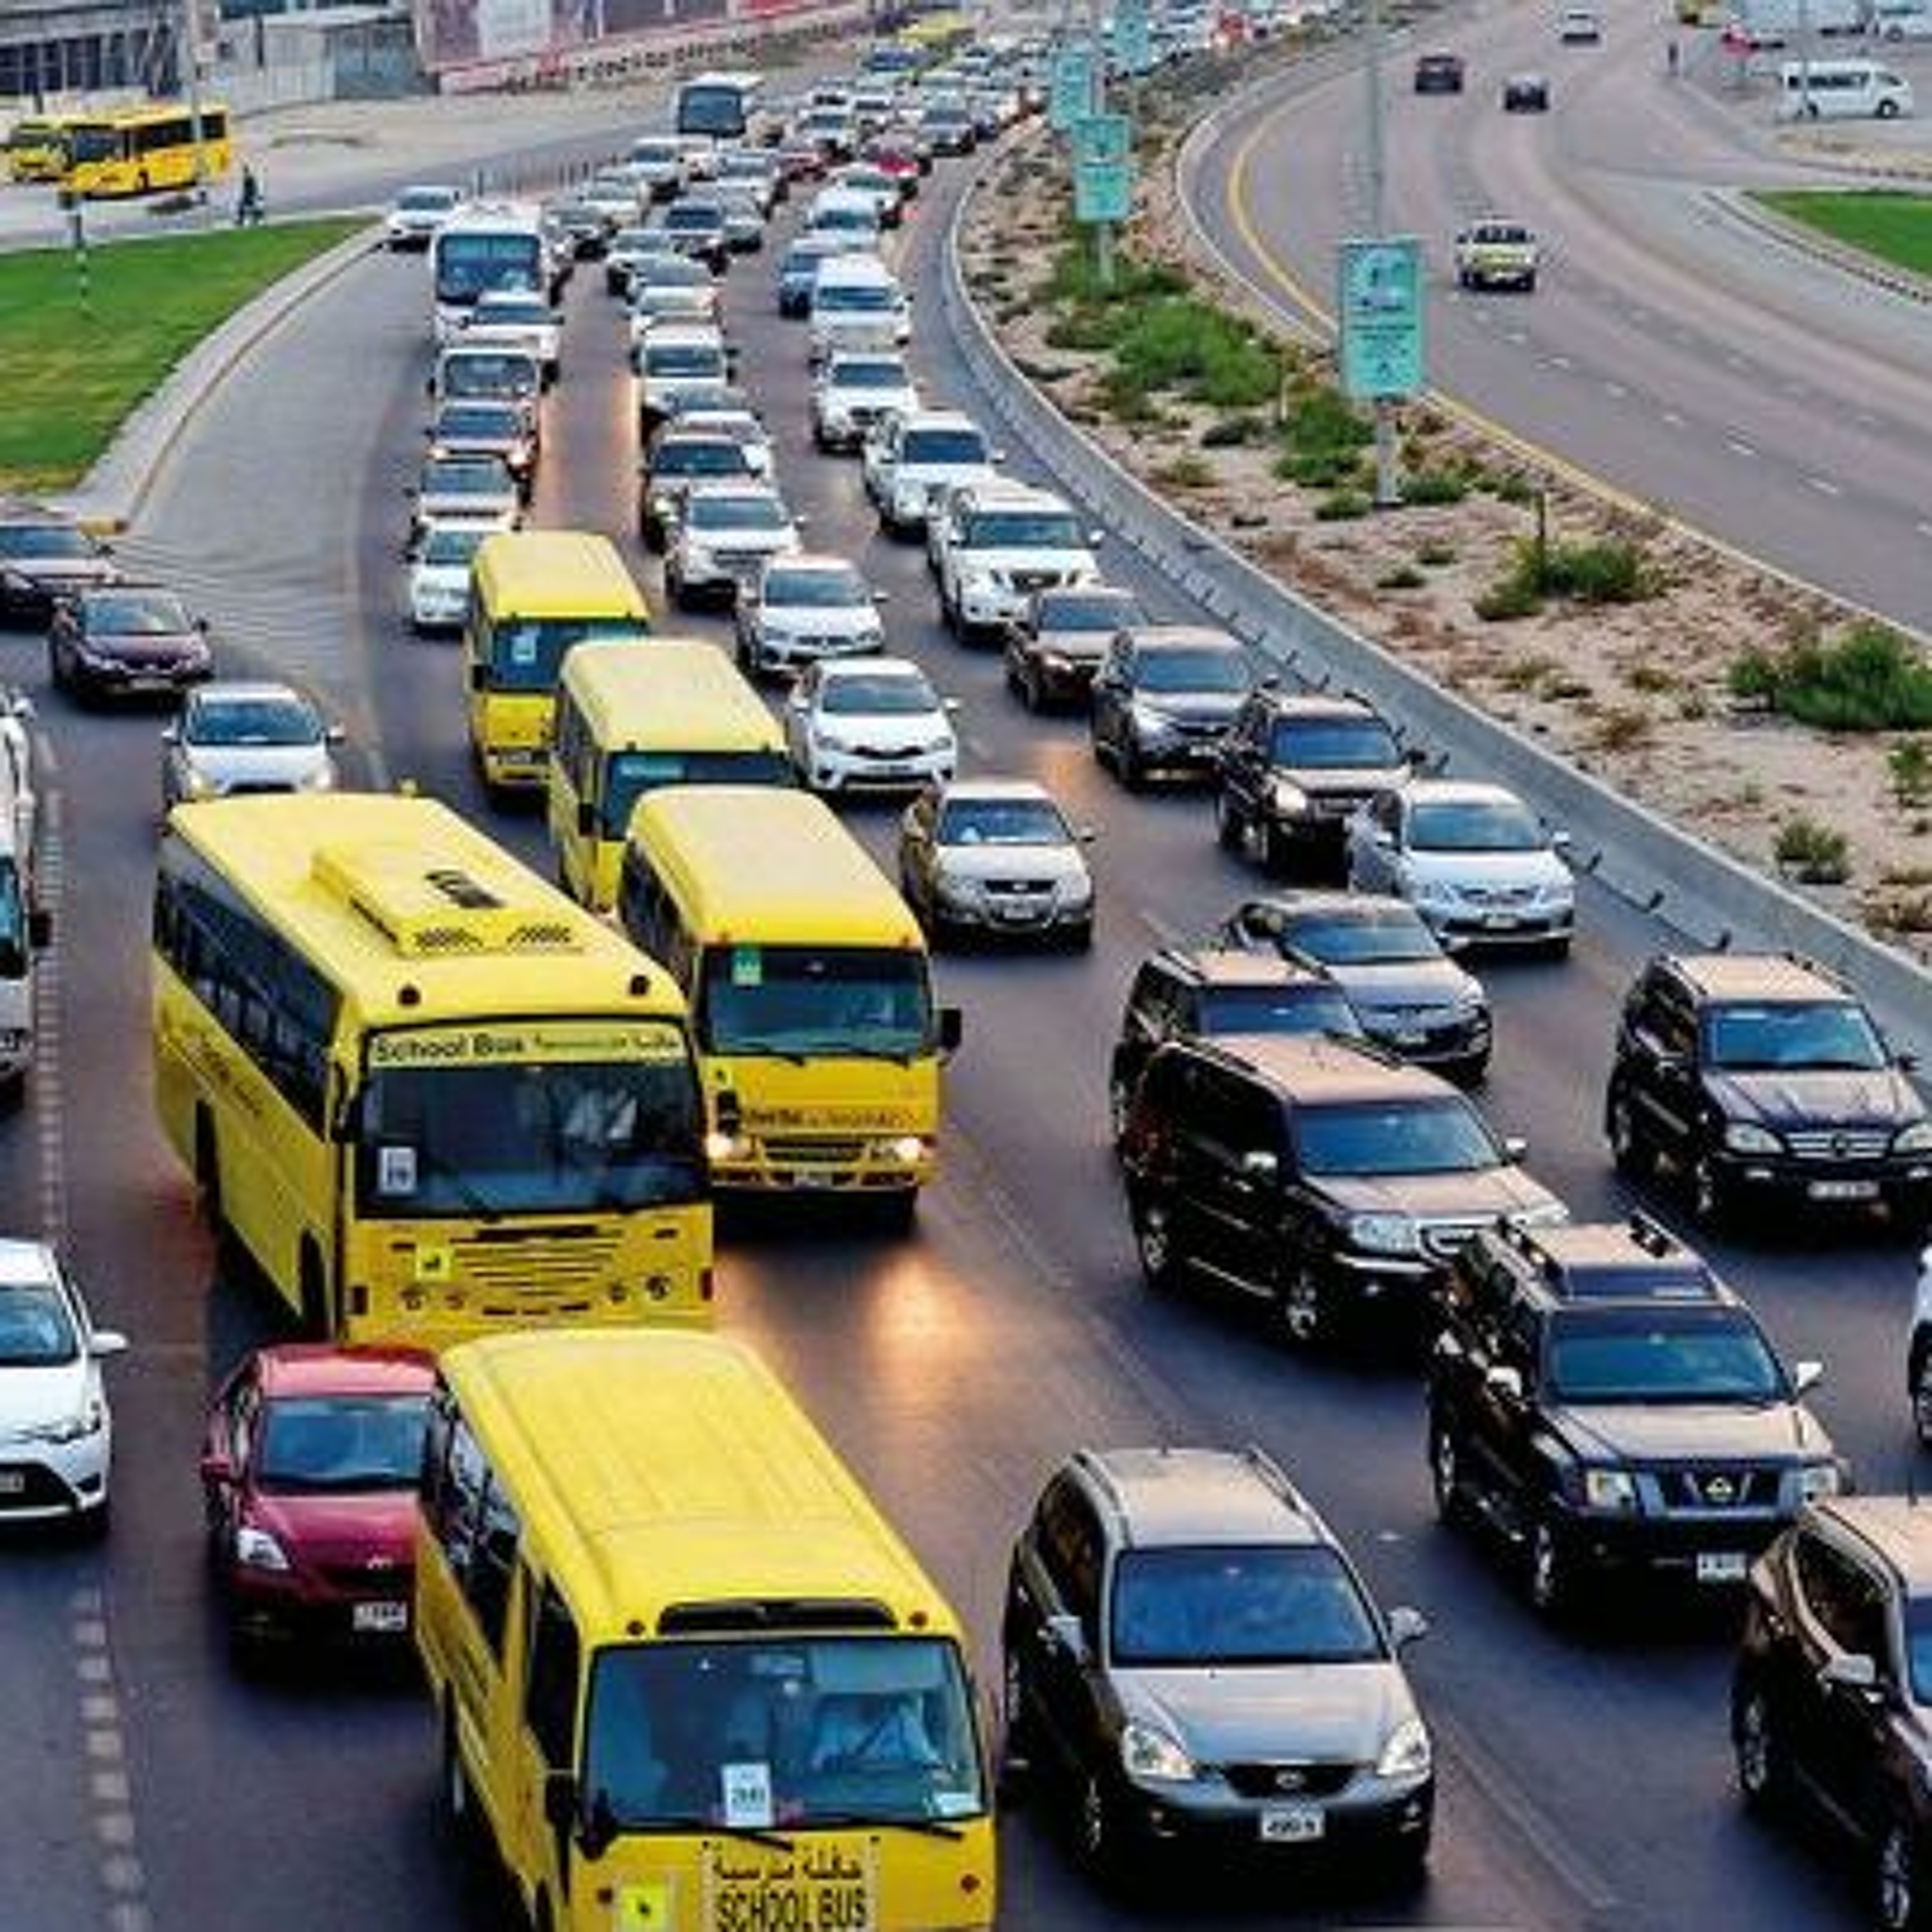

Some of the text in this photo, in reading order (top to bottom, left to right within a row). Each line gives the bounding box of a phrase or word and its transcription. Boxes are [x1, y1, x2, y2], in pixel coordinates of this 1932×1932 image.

[375, 1033, 469, 1063] School
[473, 1032, 524, 1057] Bus
[716, 1886, 866, 1932] SCHOOL BUS
